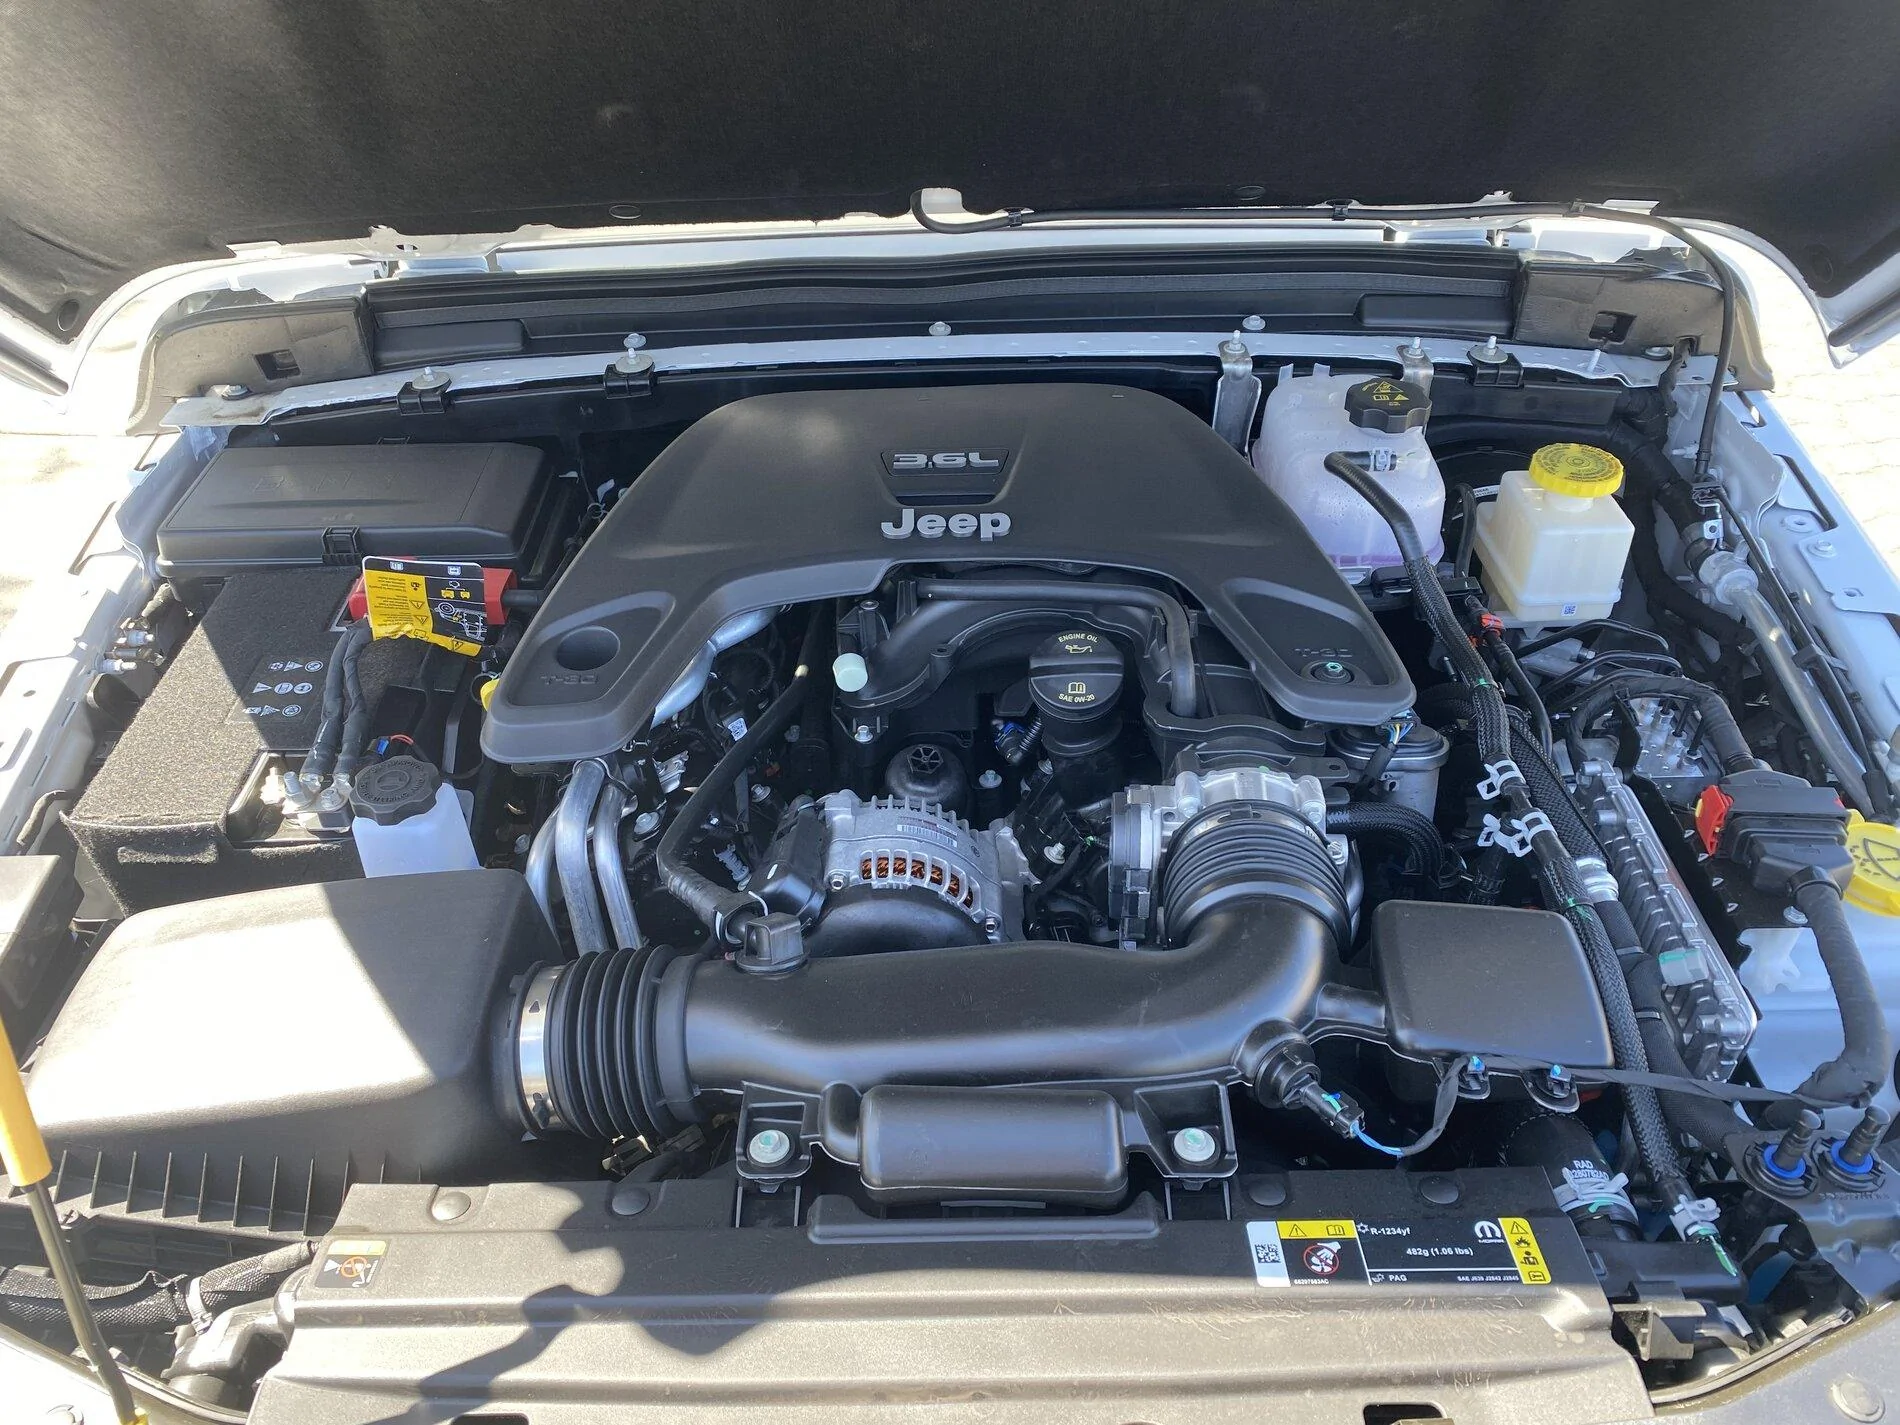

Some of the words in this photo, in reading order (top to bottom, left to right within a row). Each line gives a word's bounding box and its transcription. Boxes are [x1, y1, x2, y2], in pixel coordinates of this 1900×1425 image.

[892, 452, 999, 469] 3.6L
[880, 508, 1012, 542] Jeep
[1058, 633, 1085, 643] ENGINE
[1086, 634, 1099, 643] OIL
[1058, 693, 1073, 703] SAE
[1074, 693, 1096, 703] 0W-20
[1573, 1160, 1594, 1169] RAD
[1370, 1226, 1411, 1236] R-1234yf
[1454, 1247, 1474, 1257] lbs)
[1388, 1274, 1408, 1282] PAG
